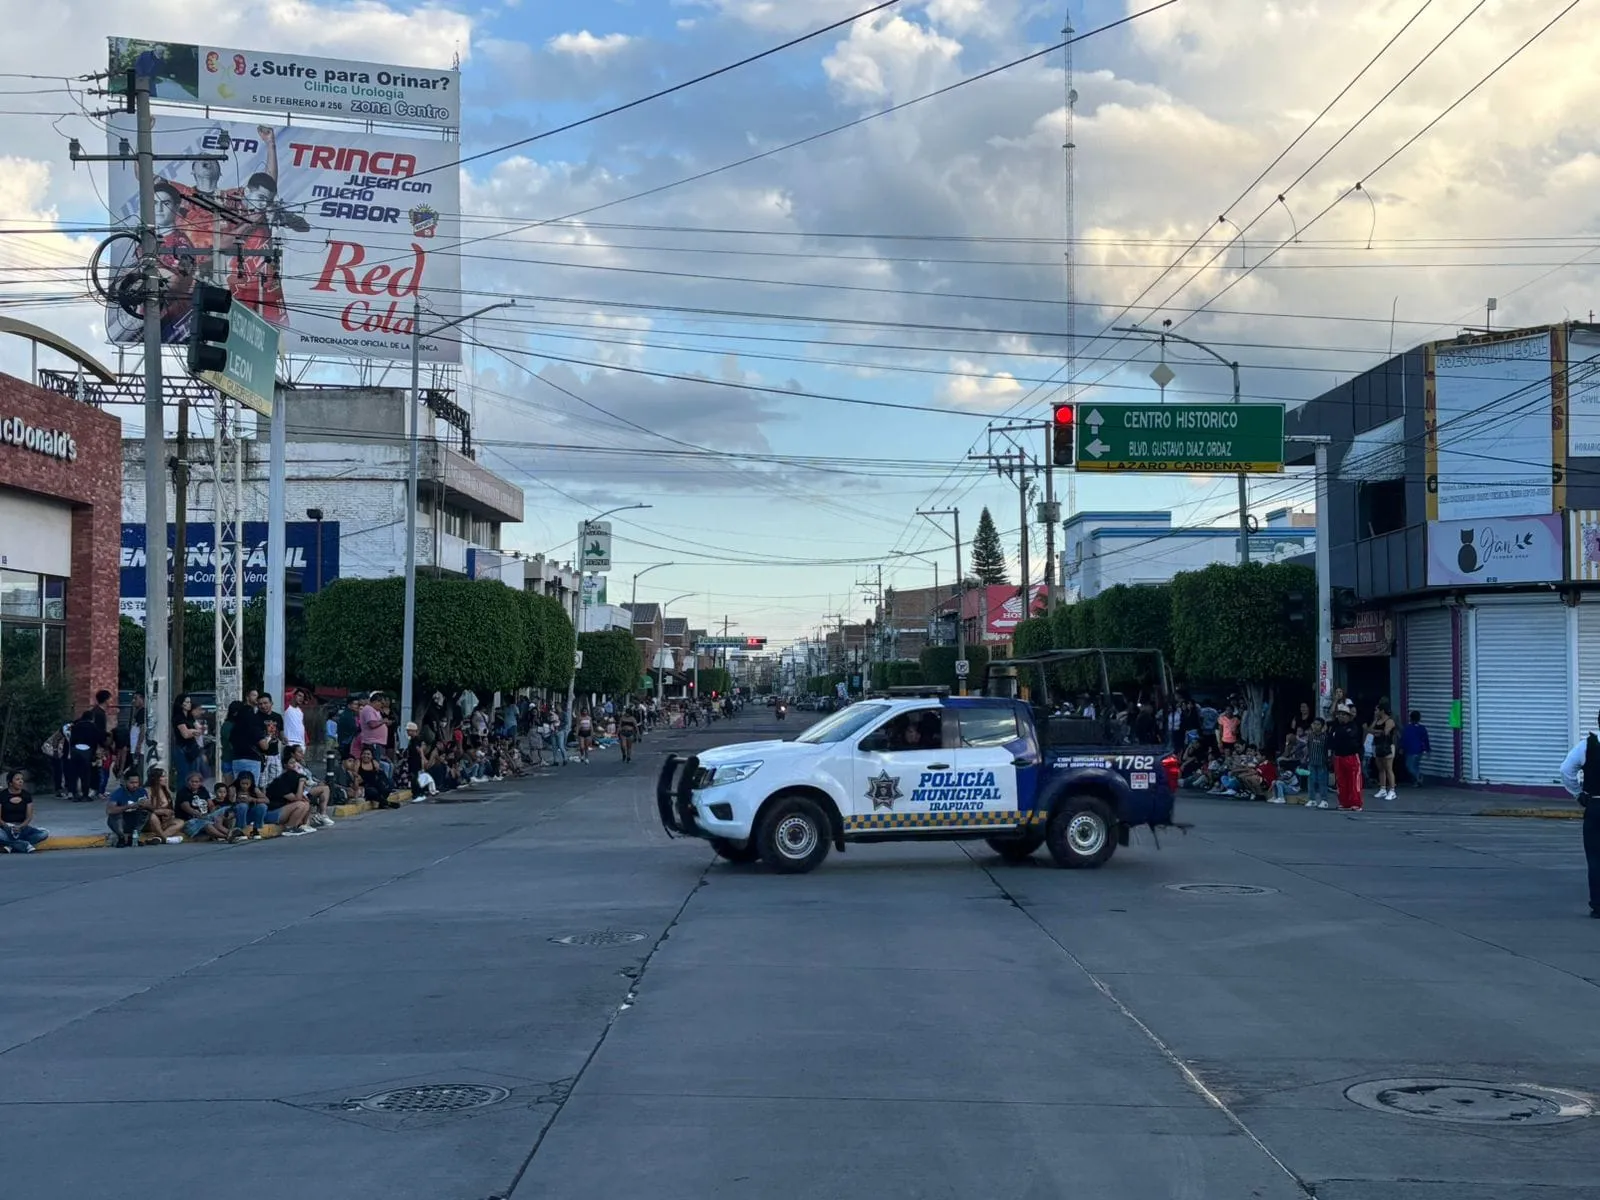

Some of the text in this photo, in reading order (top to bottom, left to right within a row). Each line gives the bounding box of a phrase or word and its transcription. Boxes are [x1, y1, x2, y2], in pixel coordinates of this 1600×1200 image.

[250, 60, 450, 91] ¿Sufre para Orinar?
[252, 95, 258, 103] 5
[259, 95, 272, 104] DE
[274, 97, 318, 108] FEBRERO
[328, 102, 343, 110] 256
[394, 101, 450, 120] Centro
[289, 143, 416, 178] TRINCA
[344, 174, 399, 191] JUEGA
[311, 185, 374, 202] MUCHO
[319, 202, 400, 224] SABOR
[309, 239, 425, 298] Red
[341, 300, 415, 335] Cola
[300, 335, 359, 346] PATROCINADOR
[361, 339, 388, 348] OFICIAL
[229, 351, 253, 383] LEON
[1124, 411, 1238, 428] CENTRO HISTORICO
[0, 415, 77, 460] cDonald's
[1129, 441, 1232, 456] BLVD. GUSTAVO DIAZ ORDAZ
[1107, 461, 1253, 470] LAZARO CARDENAS
[1115, 755, 1154, 770] 1762
[918, 768, 995, 788] POLICÍA
[910, 788, 1001, 802] MUNICIPAL
[929, 801, 984, 812] IRAPUATO
